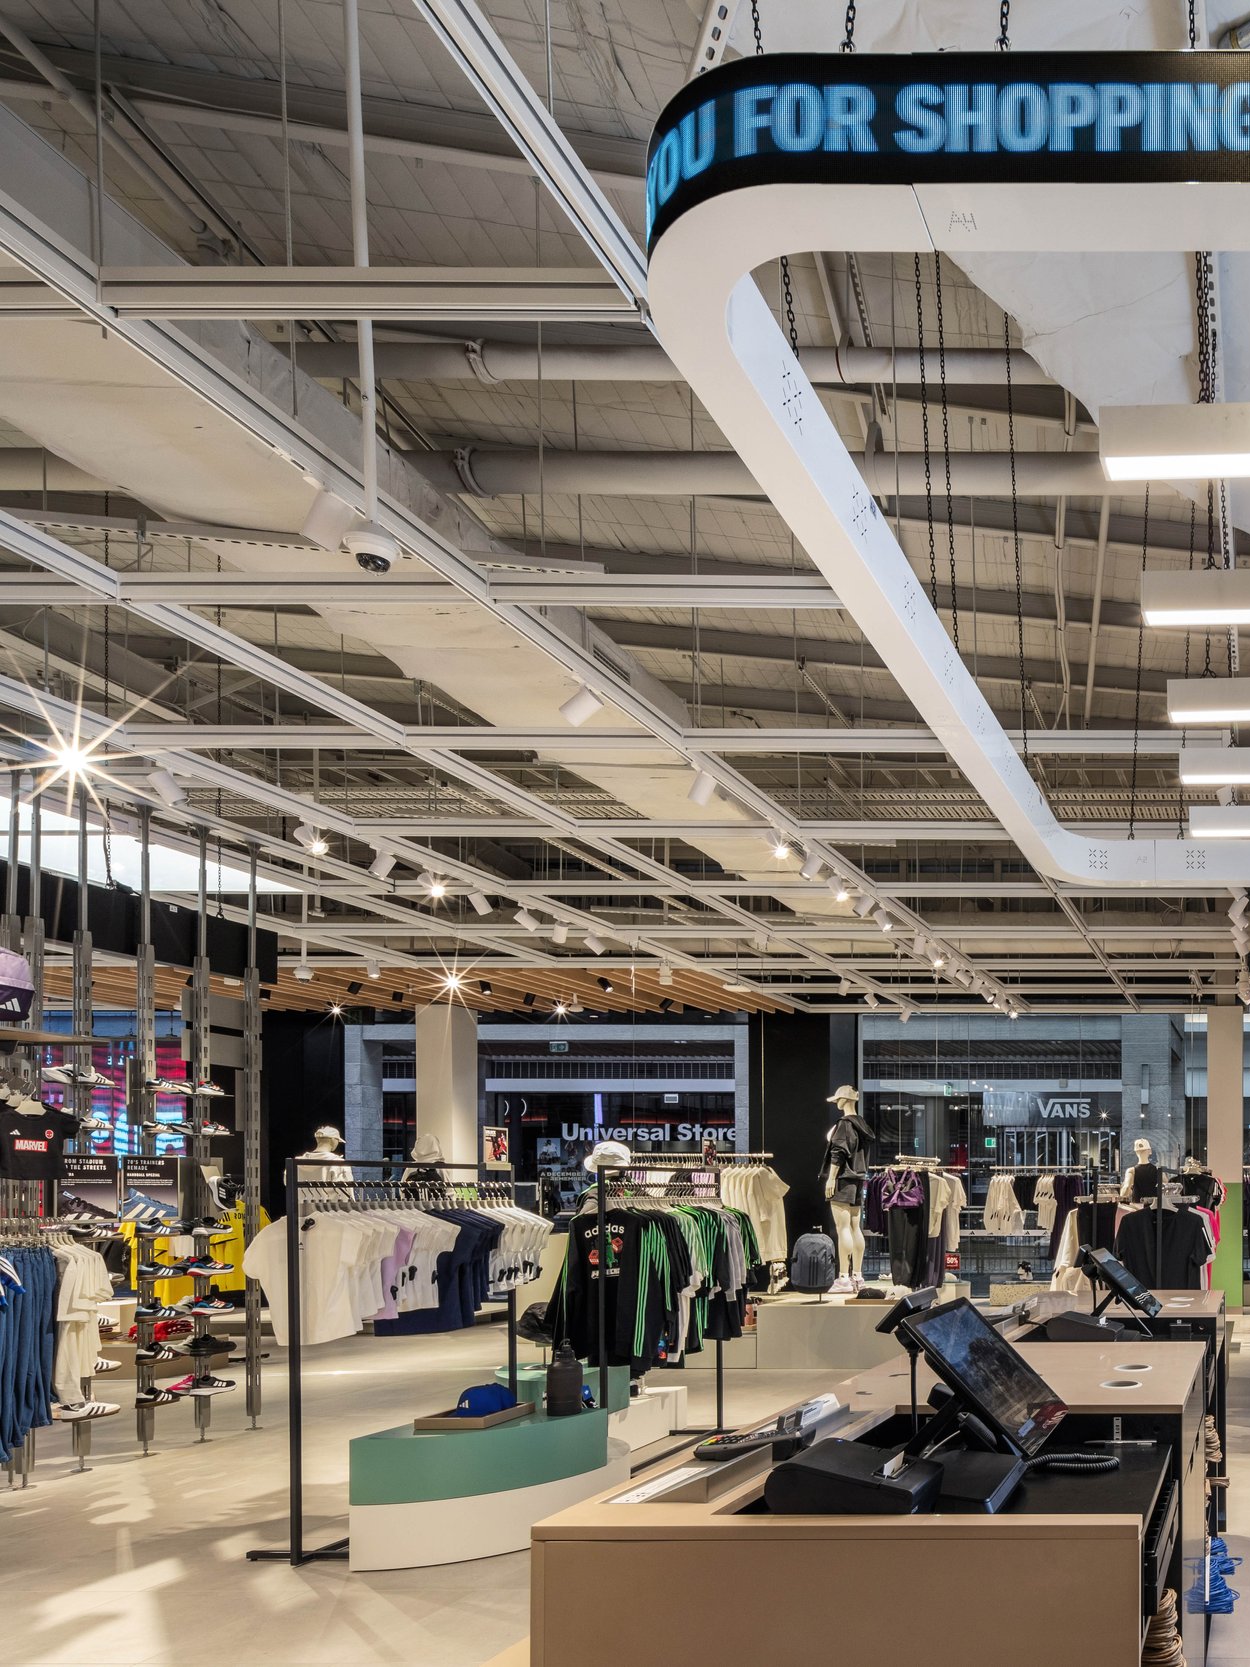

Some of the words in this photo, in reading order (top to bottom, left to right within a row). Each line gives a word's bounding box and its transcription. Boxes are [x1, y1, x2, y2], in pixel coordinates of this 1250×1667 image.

[734, 83, 879, 158] FOR
[1037, 1098, 1091, 1118] VANS
[561, 1122, 670, 1142] Universal
[677, 1123, 735, 1142] Store
[15, 1139, 47, 1152] MARVEL
[584, 1223, 625, 1239] addas
